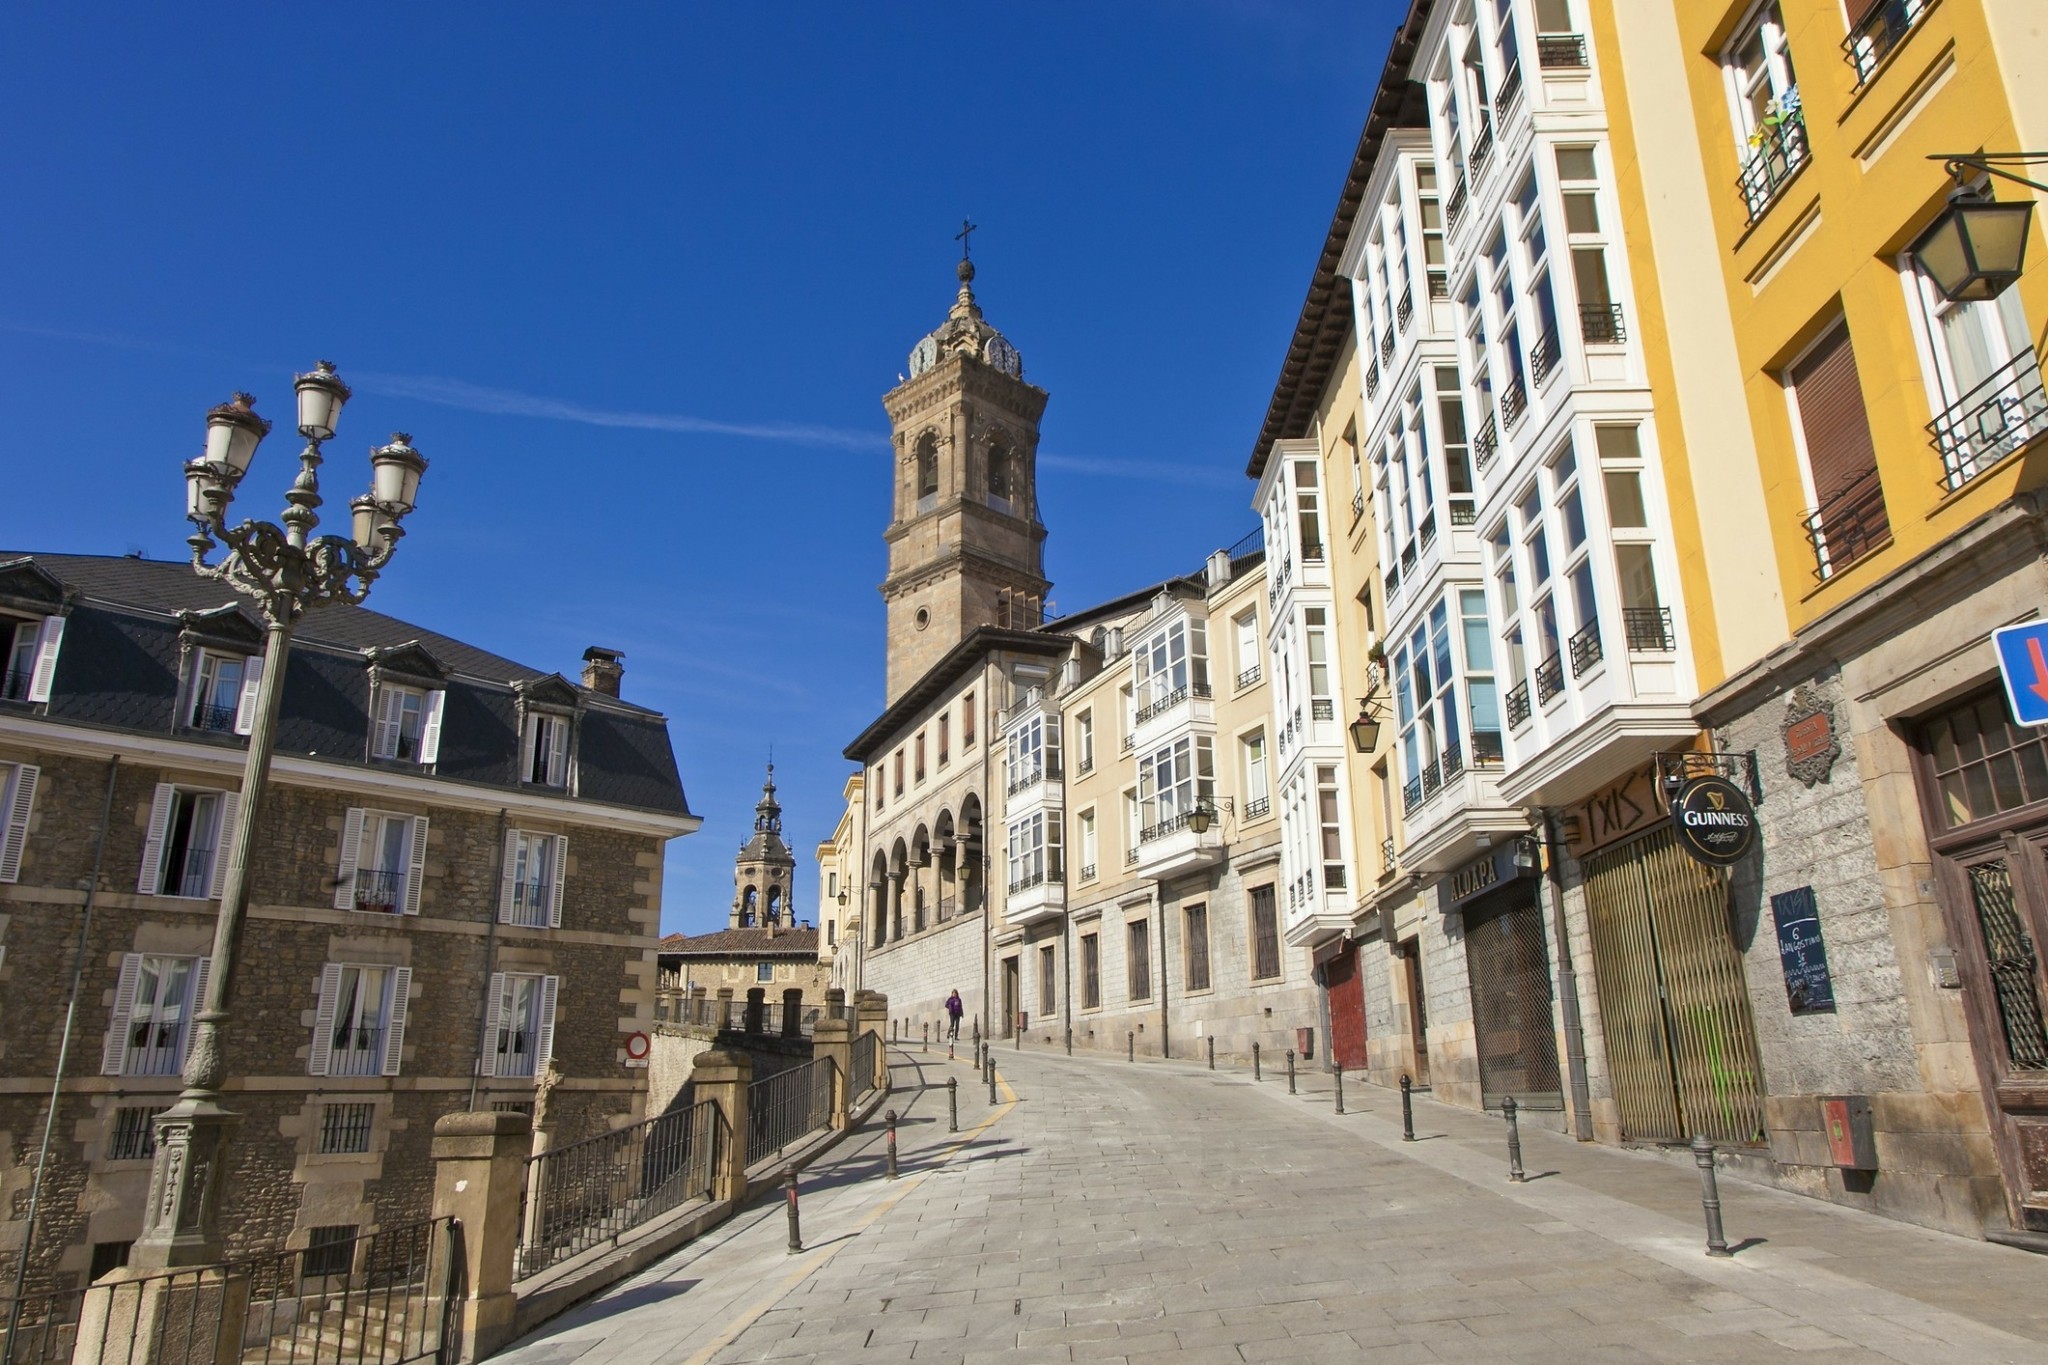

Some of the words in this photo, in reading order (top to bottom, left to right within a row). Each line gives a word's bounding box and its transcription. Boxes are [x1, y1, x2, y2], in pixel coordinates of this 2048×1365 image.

[1580, 760, 1662, 846] TXIST
[1684, 810, 1749, 827] GUINNESS
[1450, 855, 1497, 902] ALDAPA
